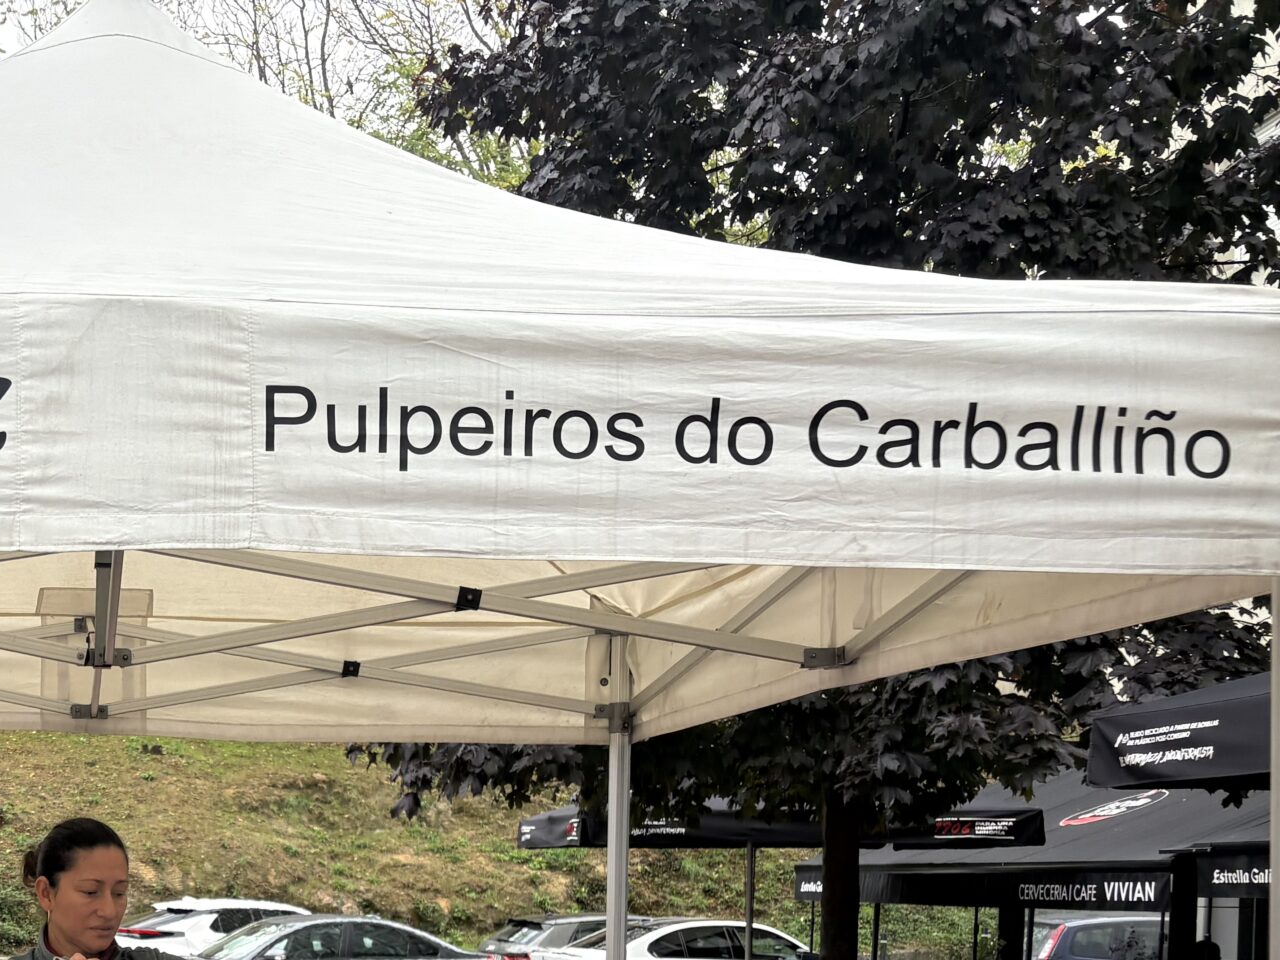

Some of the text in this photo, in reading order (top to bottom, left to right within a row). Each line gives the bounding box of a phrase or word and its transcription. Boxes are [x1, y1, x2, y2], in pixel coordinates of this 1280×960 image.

[265, 384, 1231, 479] Pulpeiros do Carballiño
[1211, 868, 1250, 884] Estrella
[1018, 884, 1068, 900] CERVECERIA
[1073, 884, 1097, 901] CAFE
[1103, 881, 1156, 902] VIVIAN
